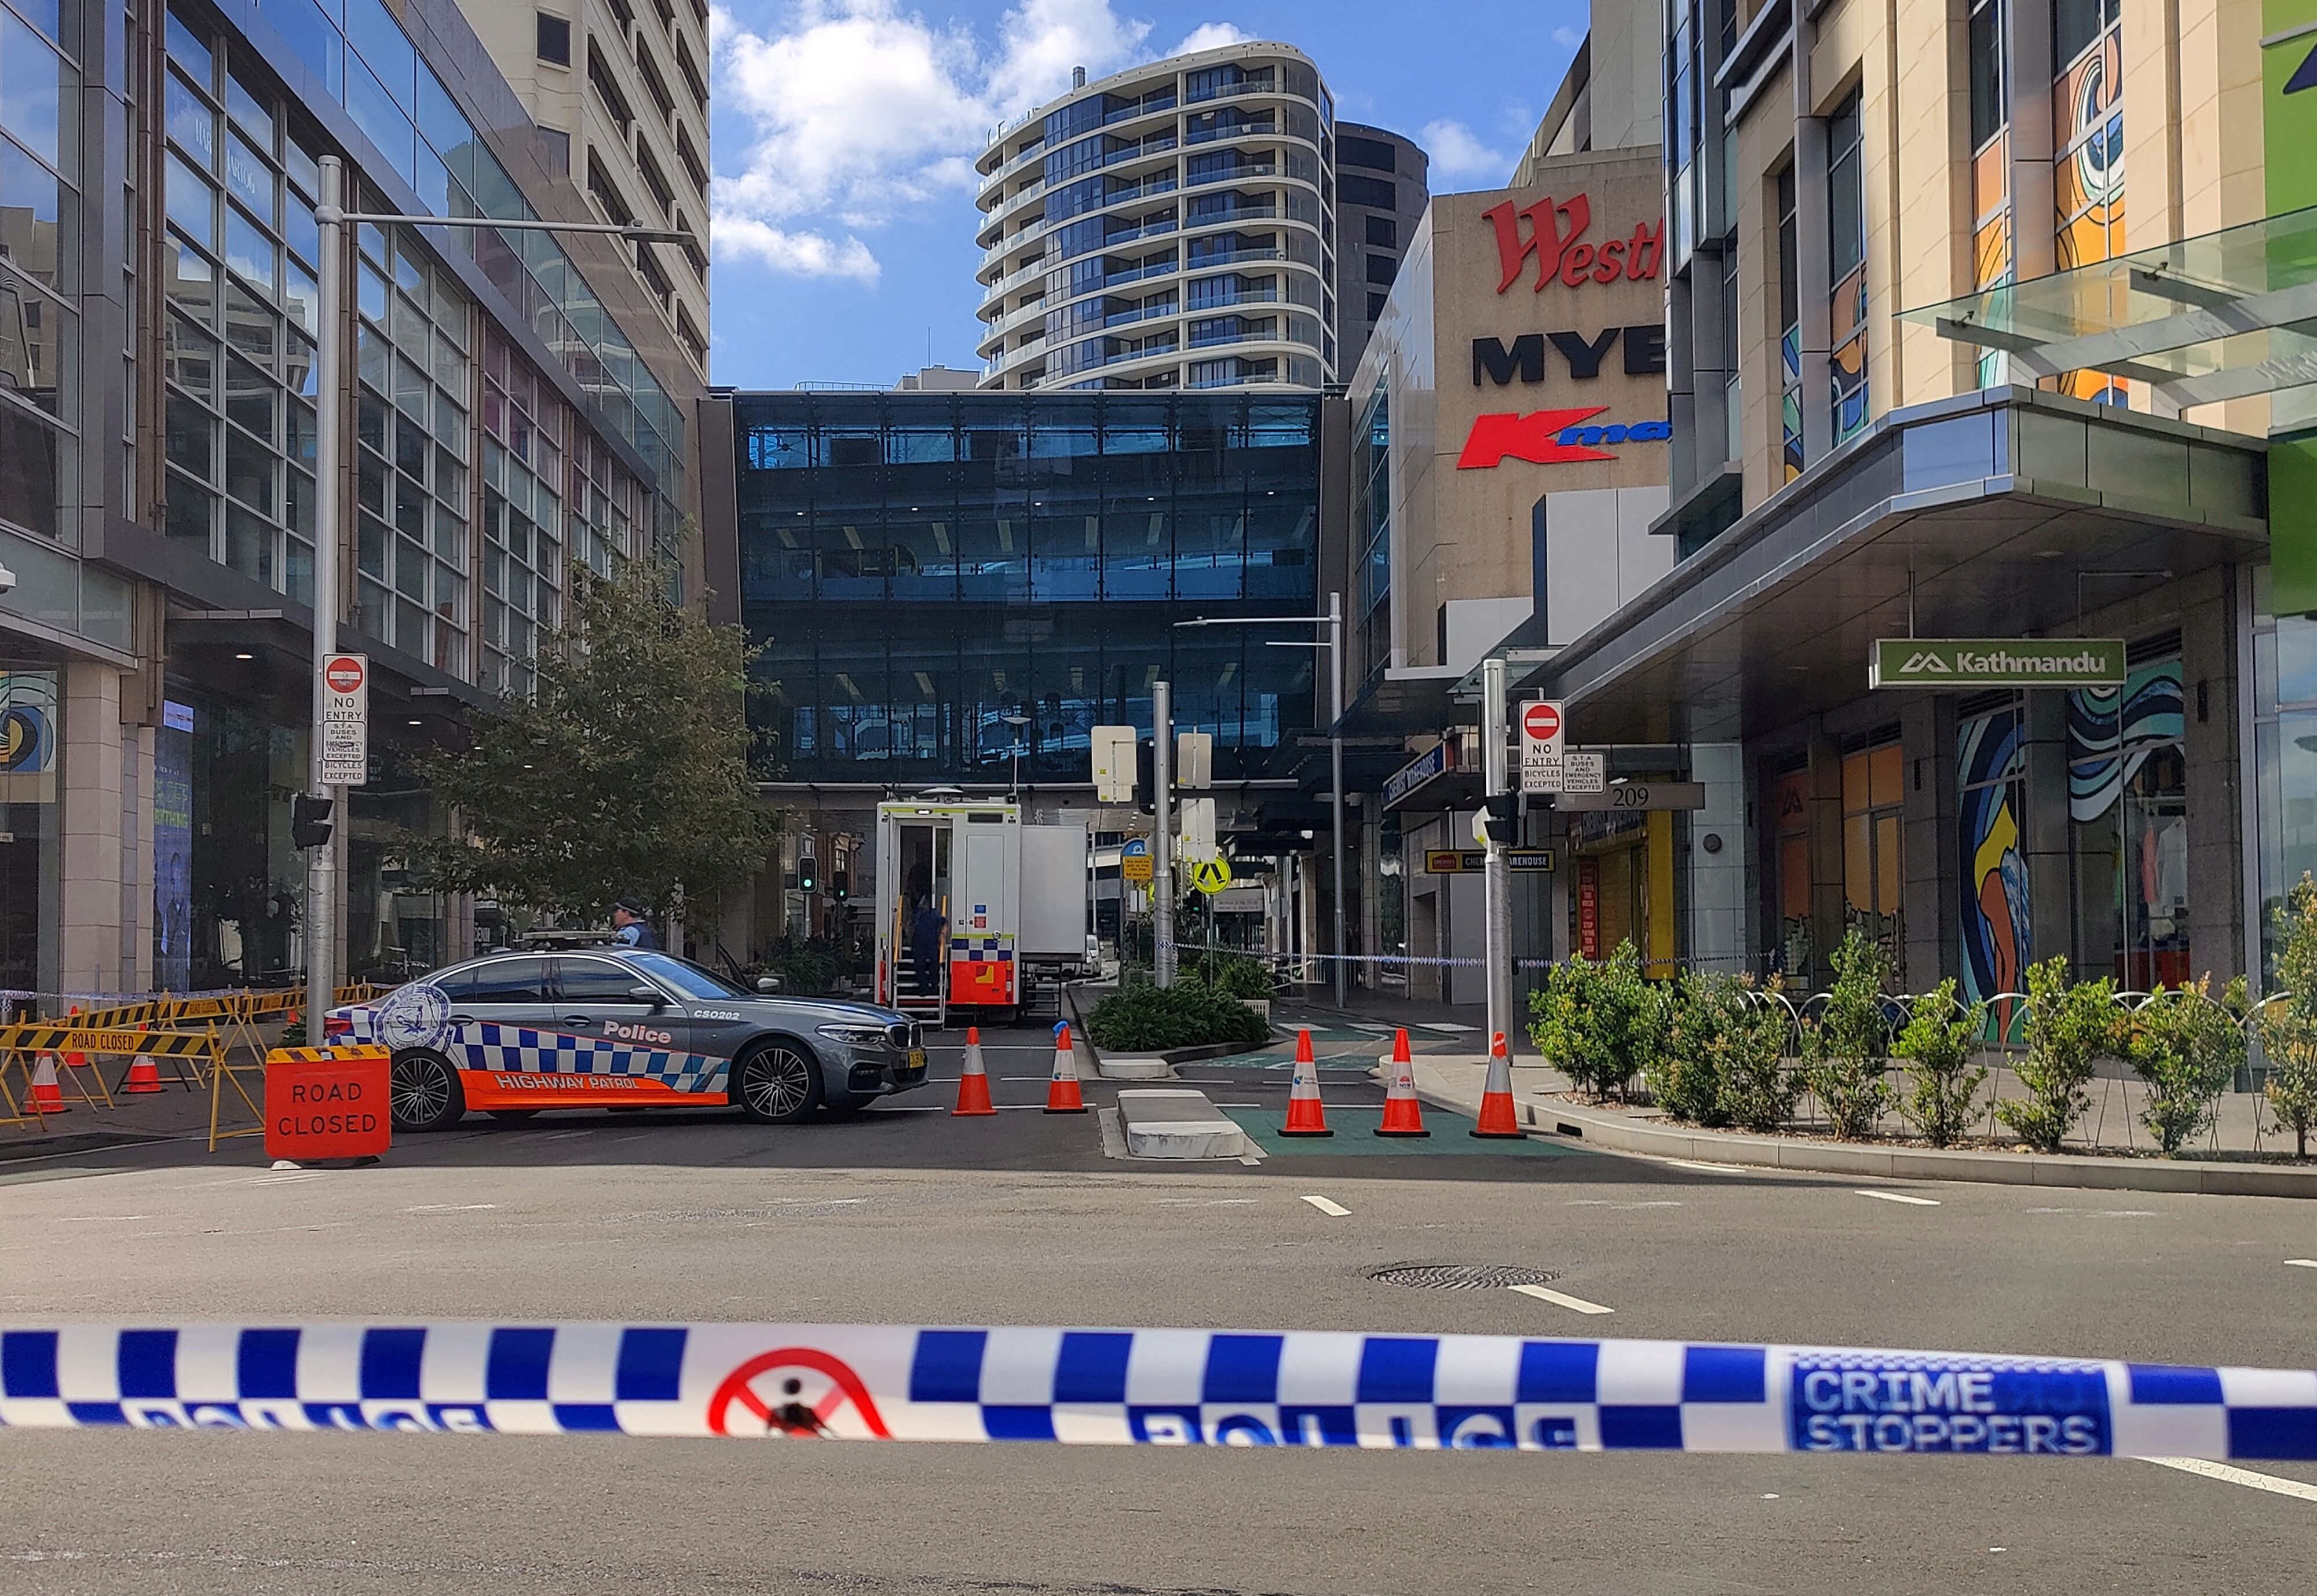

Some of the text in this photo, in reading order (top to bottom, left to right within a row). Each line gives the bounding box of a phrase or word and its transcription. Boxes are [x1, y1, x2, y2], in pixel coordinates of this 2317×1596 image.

[1472, 323, 1666, 387] MYE
[1956, 651, 2106, 673] Kathmandu
[334, 697, 355, 708] NO
[326, 711, 362, 720] ENTRY
[1532, 744, 1552, 754] NO
[1525, 757, 1560, 766] ENTRY
[324, 772, 363, 780] EXCEPTED
[1524, 780, 1561, 788] EXCEPTED
[1613, 787, 1649, 807] 209
[603, 1020, 672, 1044] Police
[72, 1033, 134, 1050] ROAD CLOSED
[494, 1074, 640, 1090] HIGHWAY PATROL
[278, 1082, 377, 1136] ROAD CLOSED
[1803, 1370, 1996, 1412] CRIME
[1805, 1414, 2100, 1453] STOPPERS
